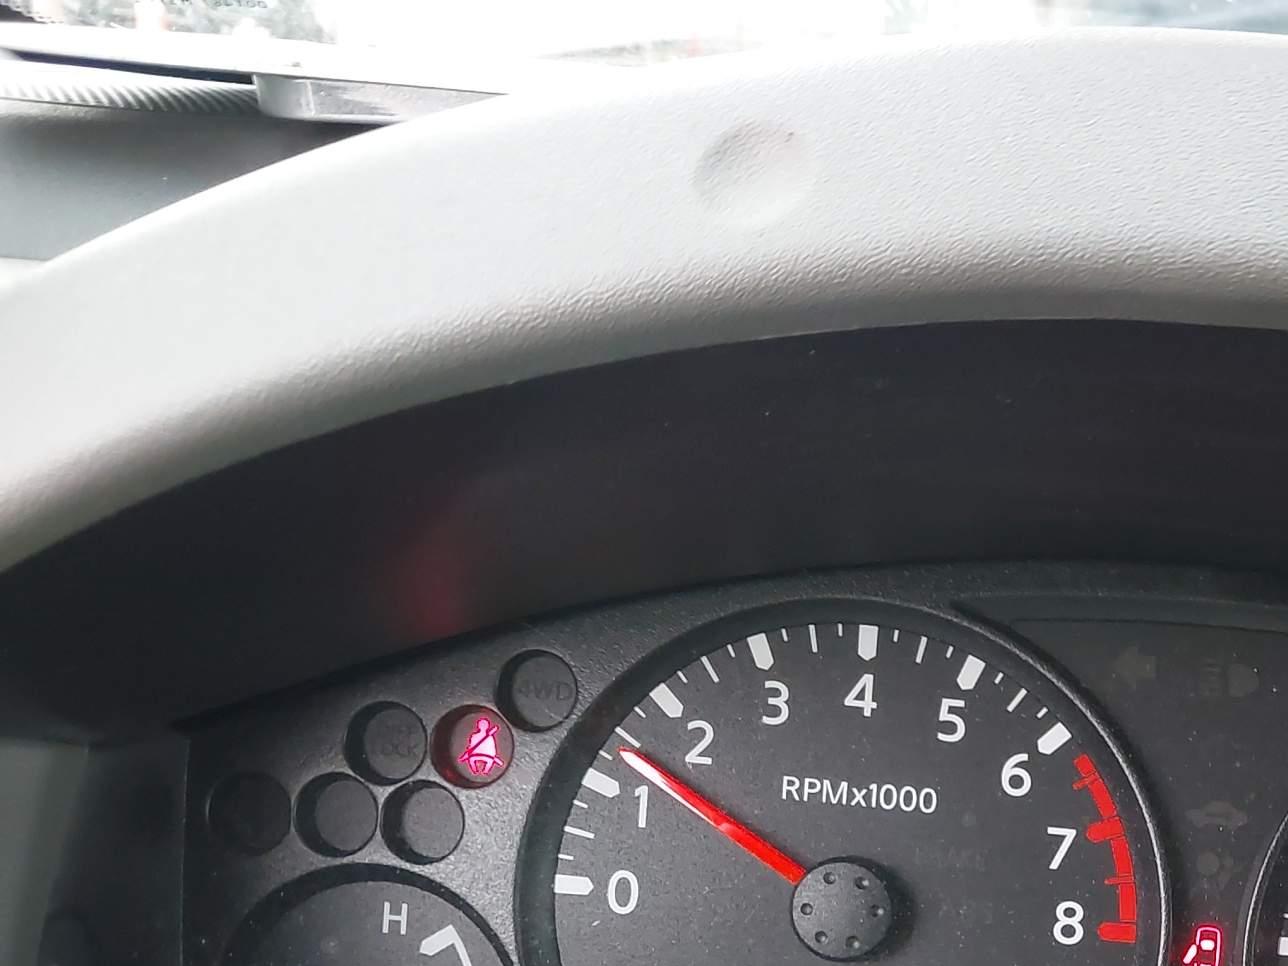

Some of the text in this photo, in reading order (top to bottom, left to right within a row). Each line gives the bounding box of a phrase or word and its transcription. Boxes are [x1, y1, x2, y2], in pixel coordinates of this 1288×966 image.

[761, 680, 789, 726] 3
[843, 673, 878, 717] 4
[684, 720, 714, 764] 2
[937, 697, 966, 743] 5
[781, 776, 937, 814] RPMx1000
[1001, 753, 1032, 797] 6
[634, 785, 649, 828] 1
[1047, 826, 1077, 870] 7
[606, 869, 639, 915] 0
[382, 901, 408, 935] H
[1052, 900, 1084, 945] 8
